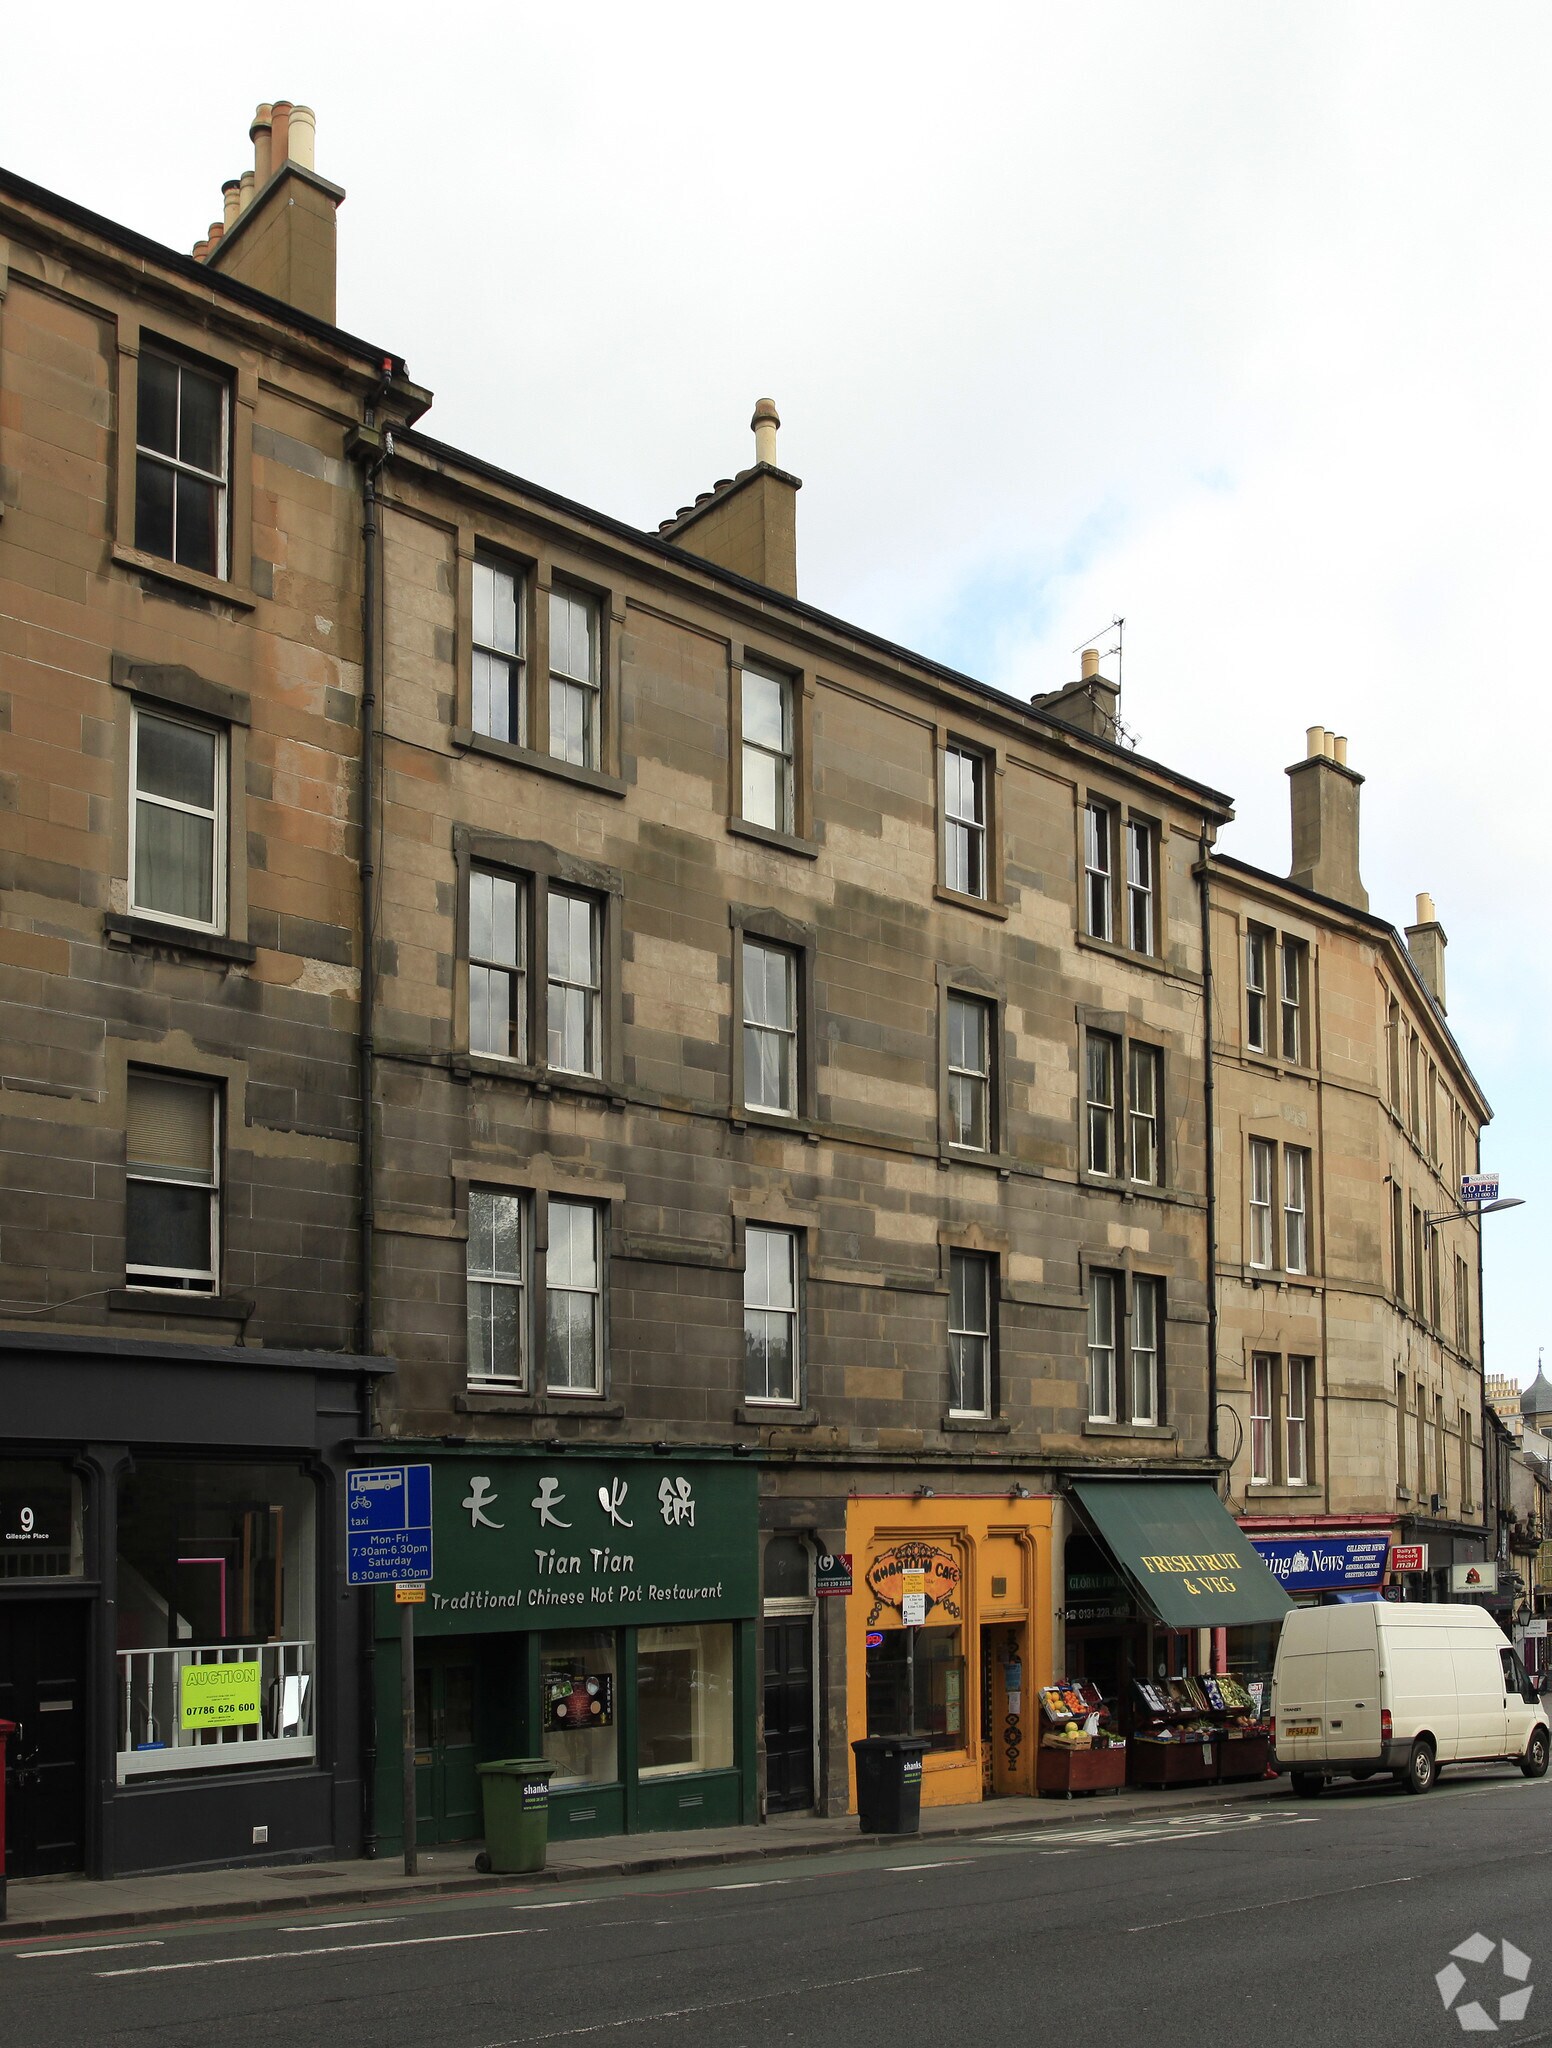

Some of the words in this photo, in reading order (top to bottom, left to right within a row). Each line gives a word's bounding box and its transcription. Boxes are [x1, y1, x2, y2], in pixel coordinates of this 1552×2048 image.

[1462, 1185, 1476, 1194] TO
[1479, 1184, 1497, 1192] LET
[20, 1507, 34, 1532] 9
[351, 1516, 369, 1526] taxi
[370, 1534, 409, 1544] Mon-Fri
[352, 1544, 428, 1557] 7.30am-6.30pm
[1346, 1544, 1372, 1552] GILLESPIE
[1372, 1543, 1386, 1551] NEWS
[368, 1556, 412, 1567] Saturday
[534, 1548, 581, 1574] Tian
[589, 1547, 634, 1572] Tian
[1140, 1555, 1199, 1573] FRESH
[1192, 1553, 1242, 1571] FRUIT
[1309, 1550, 1345, 1572] News
[1396, 1559, 1418, 1569] mail
[352, 1568, 429, 1581] 8.30am-6.30pm
[1070, 1577, 1100, 1589] GLOBAL
[1183, 1578, 1201, 1595] &
[1196, 1576, 1236, 1593] VEG
[431, 1589, 522, 1610] Traditional
[528, 1588, 585, 1605] Chinese
[591, 1586, 614, 1603] Hot
[620, 1584, 642, 1601] Pot
[648, 1581, 723, 1600] Restaurant
[1078, 1609, 1094, 1619] 0131
[186, 1669, 256, 1687] AUCTION
[186, 1706, 214, 1715] 07786
[218, 1704, 235, 1713] 626
[238, 1703, 255, 1711] 600
[1288, 1727, 1303, 1735] PF54
